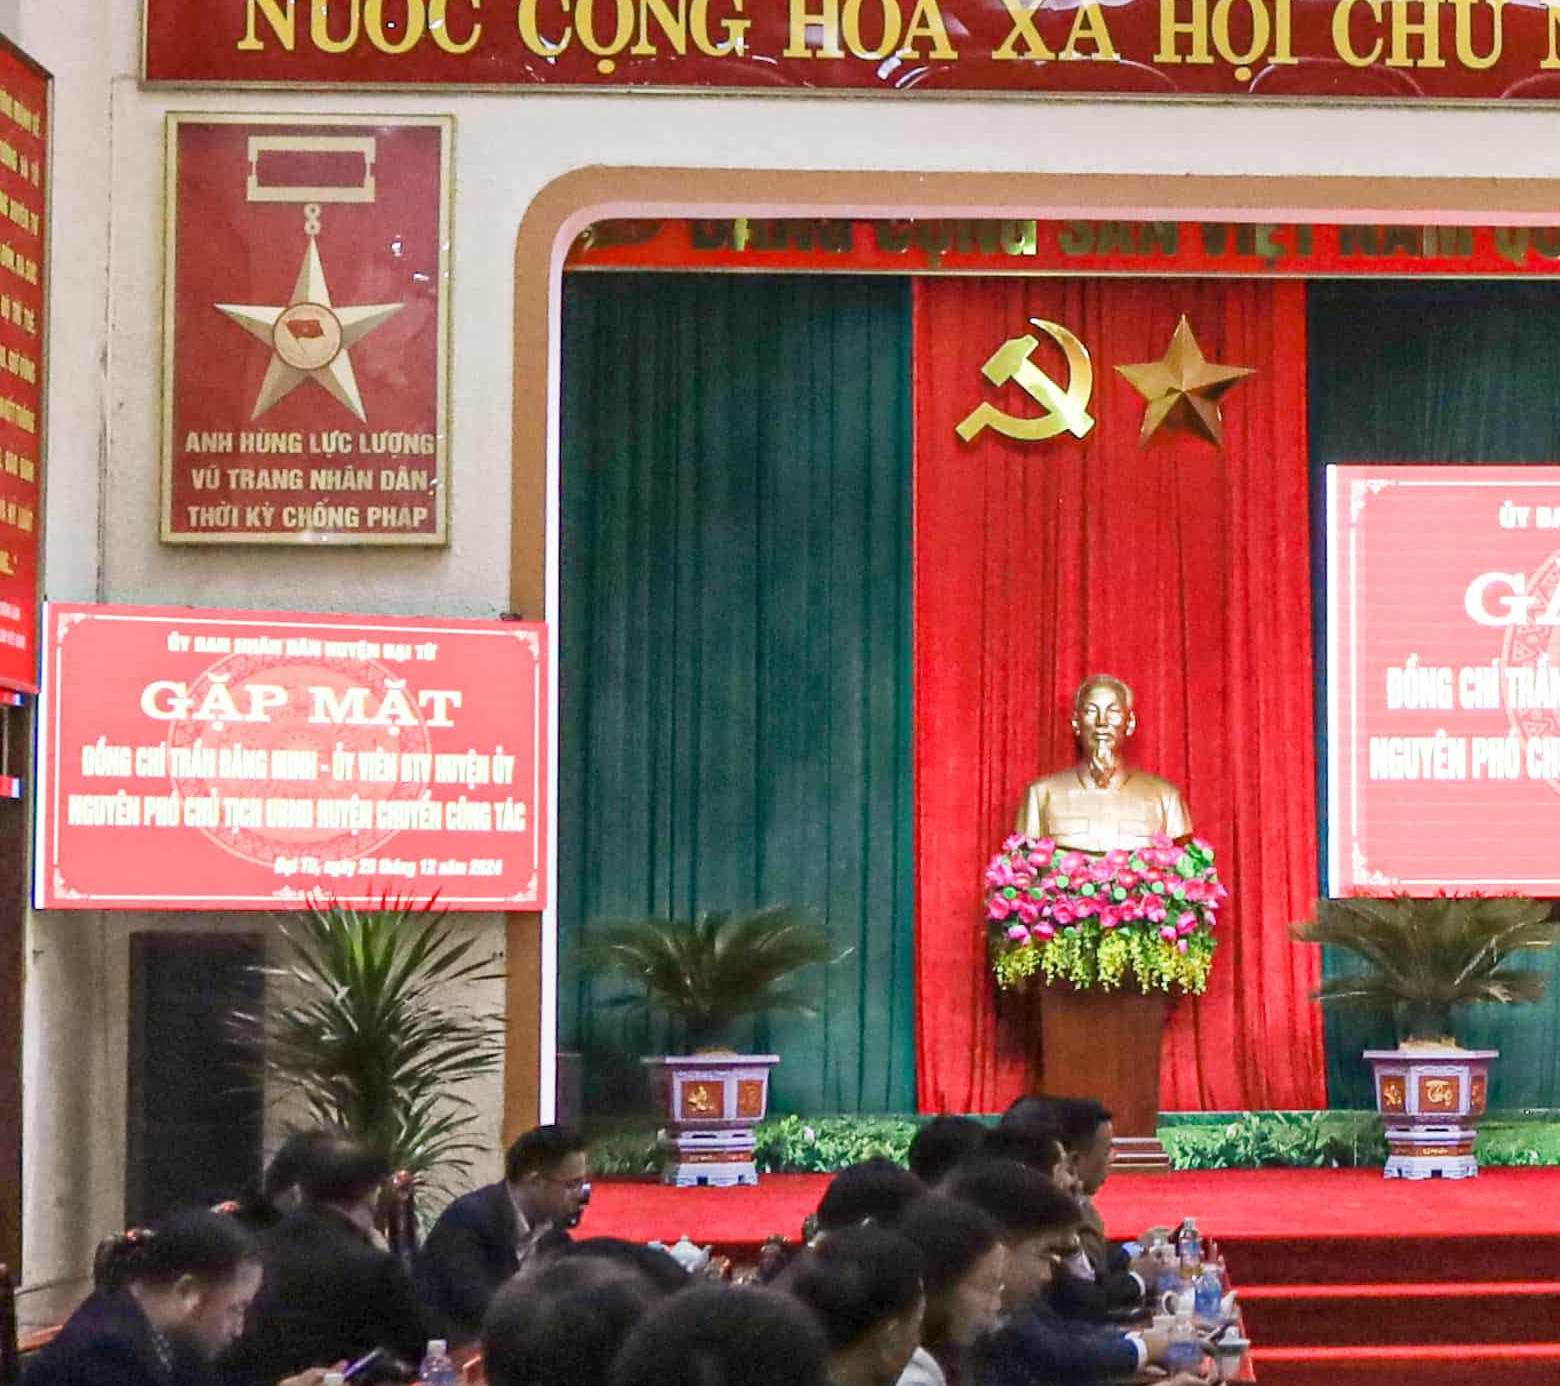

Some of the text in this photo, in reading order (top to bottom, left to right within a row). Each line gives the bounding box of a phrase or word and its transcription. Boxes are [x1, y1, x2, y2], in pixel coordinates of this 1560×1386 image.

[185, 428, 435, 459] ANH HÙNG LỰC LƯỢNG
[192, 465, 428, 490] VŨ TRANG NHÂN DÂN
[282, 498, 360, 528] CHỐNG
[1499, 501, 1530, 528] ỦY
[1459, 657, 1500, 709] CHÍ
[140, 673, 462, 737] GẶP MẶT
[1369, 728, 1467, 779] NGUYÊN
[1471, 727, 1520, 779] PHÓ
[494, 797, 527, 832] TÁC
